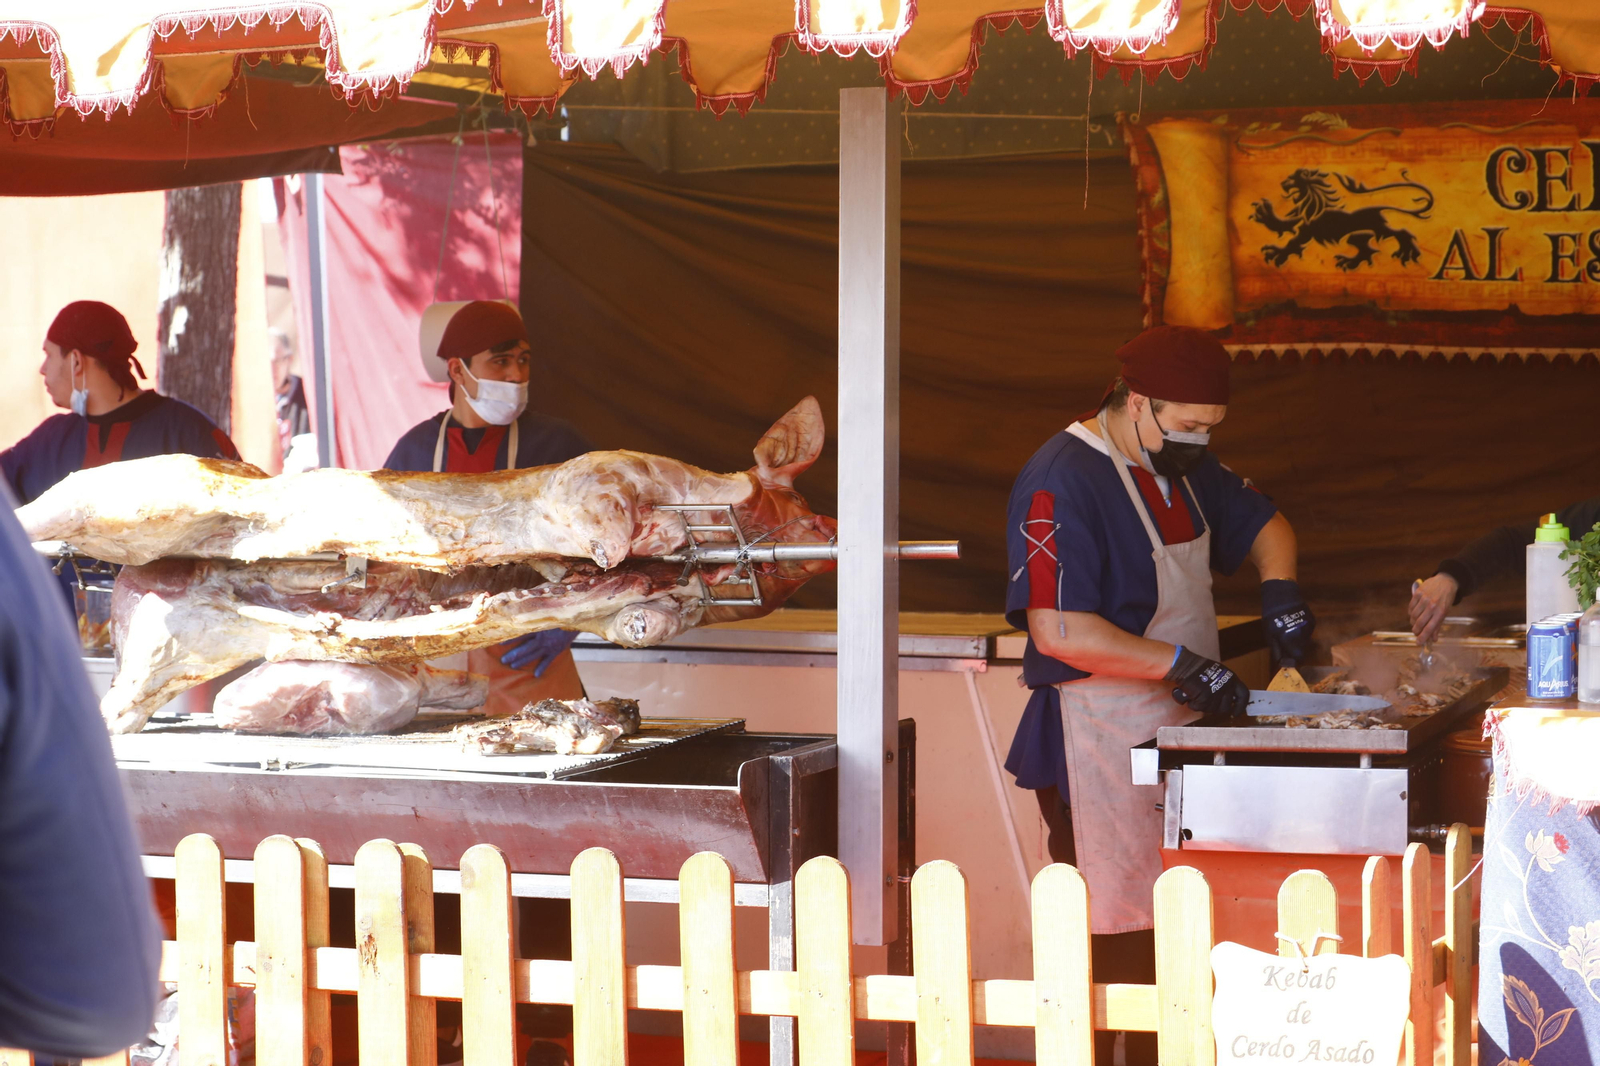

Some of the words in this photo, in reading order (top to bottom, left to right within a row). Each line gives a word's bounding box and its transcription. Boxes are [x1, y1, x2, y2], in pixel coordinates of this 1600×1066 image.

[1485, 139, 1600, 212] CE
[1428, 226, 1523, 282] AL
[1263, 965, 1337, 991] Kebab
[1286, 1001, 1312, 1024] de
[1231, 1035, 1295, 1059] Cerdo
[1298, 1039, 1375, 1064] Asado
